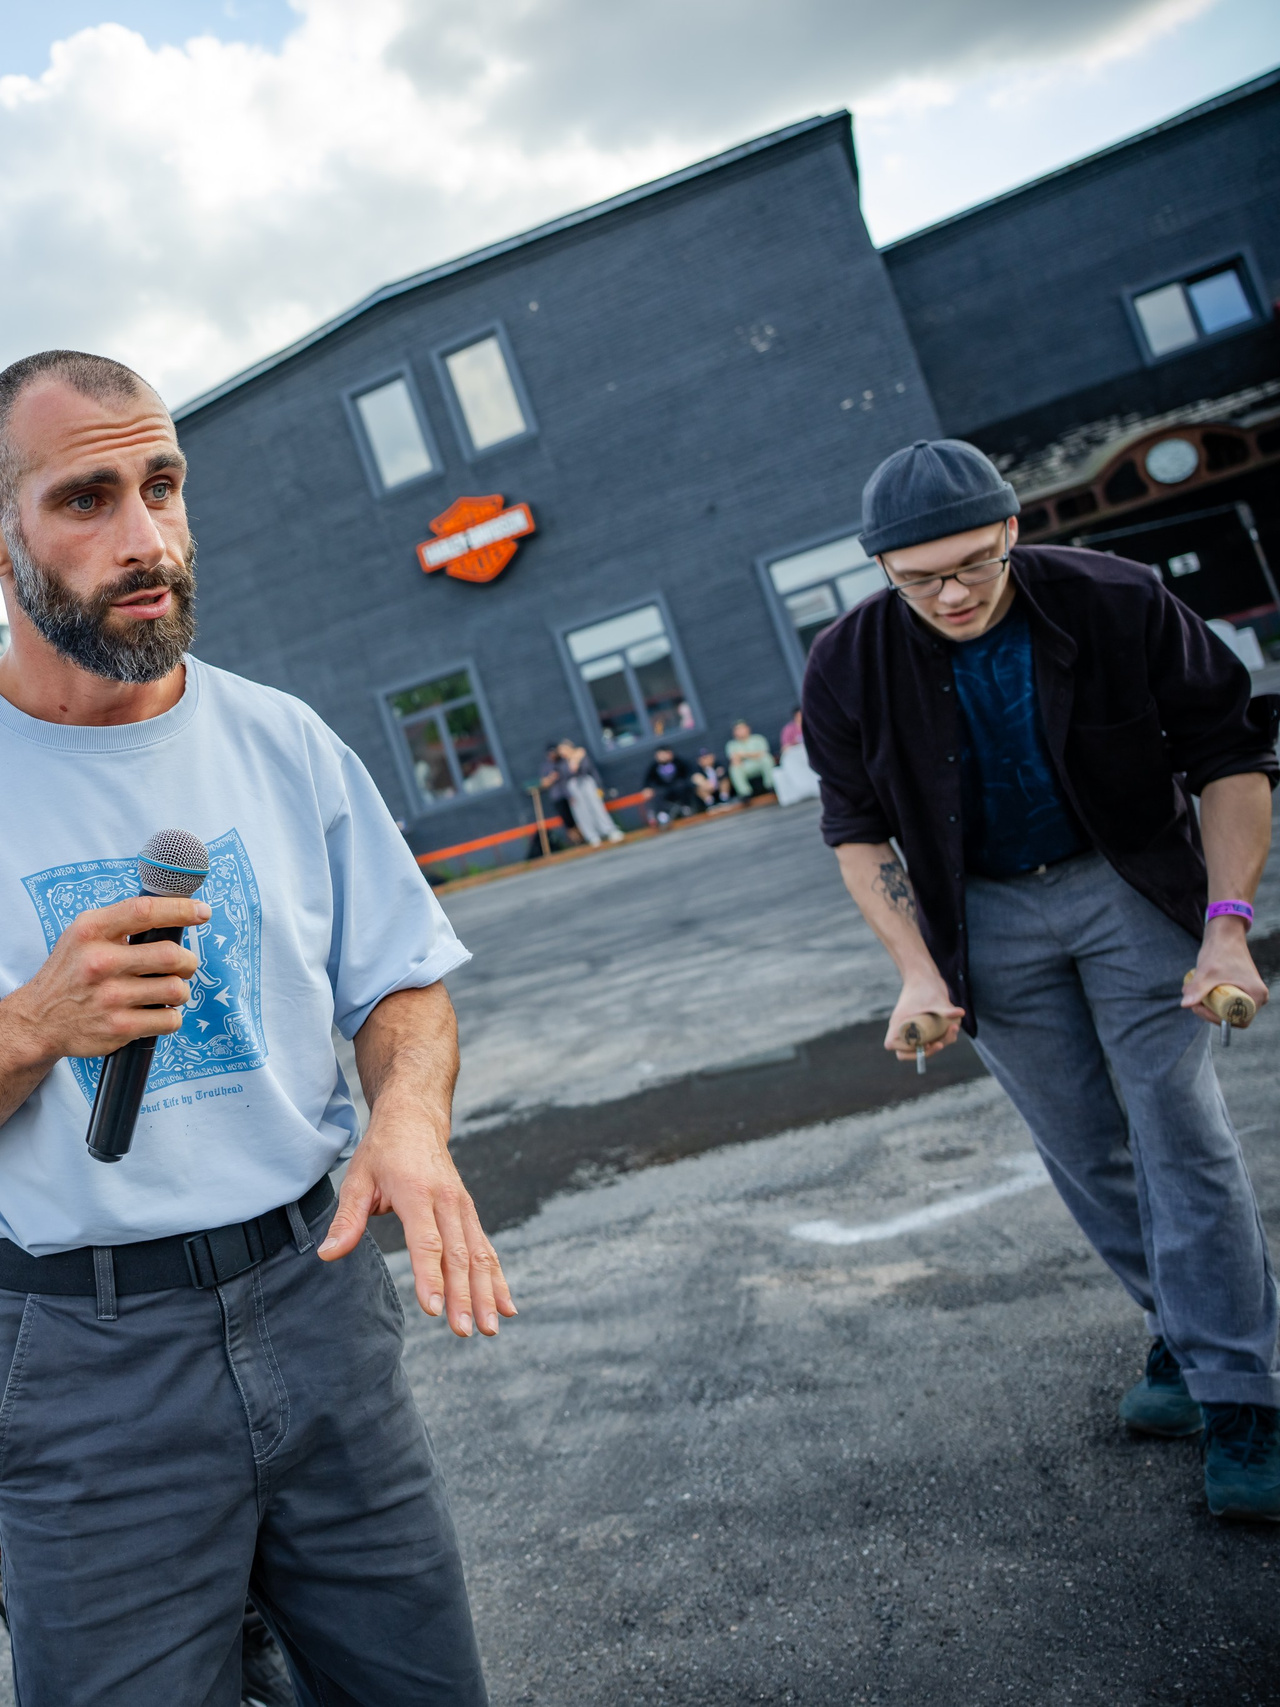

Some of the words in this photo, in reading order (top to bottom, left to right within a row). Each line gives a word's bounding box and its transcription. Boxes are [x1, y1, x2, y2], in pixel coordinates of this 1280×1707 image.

[140, 1102, 160, 1114] Skuf
[162, 1096, 179, 1109] Life
[181, 1094, 193, 1105] by
[195, 1084, 243, 1101] Trailhead
